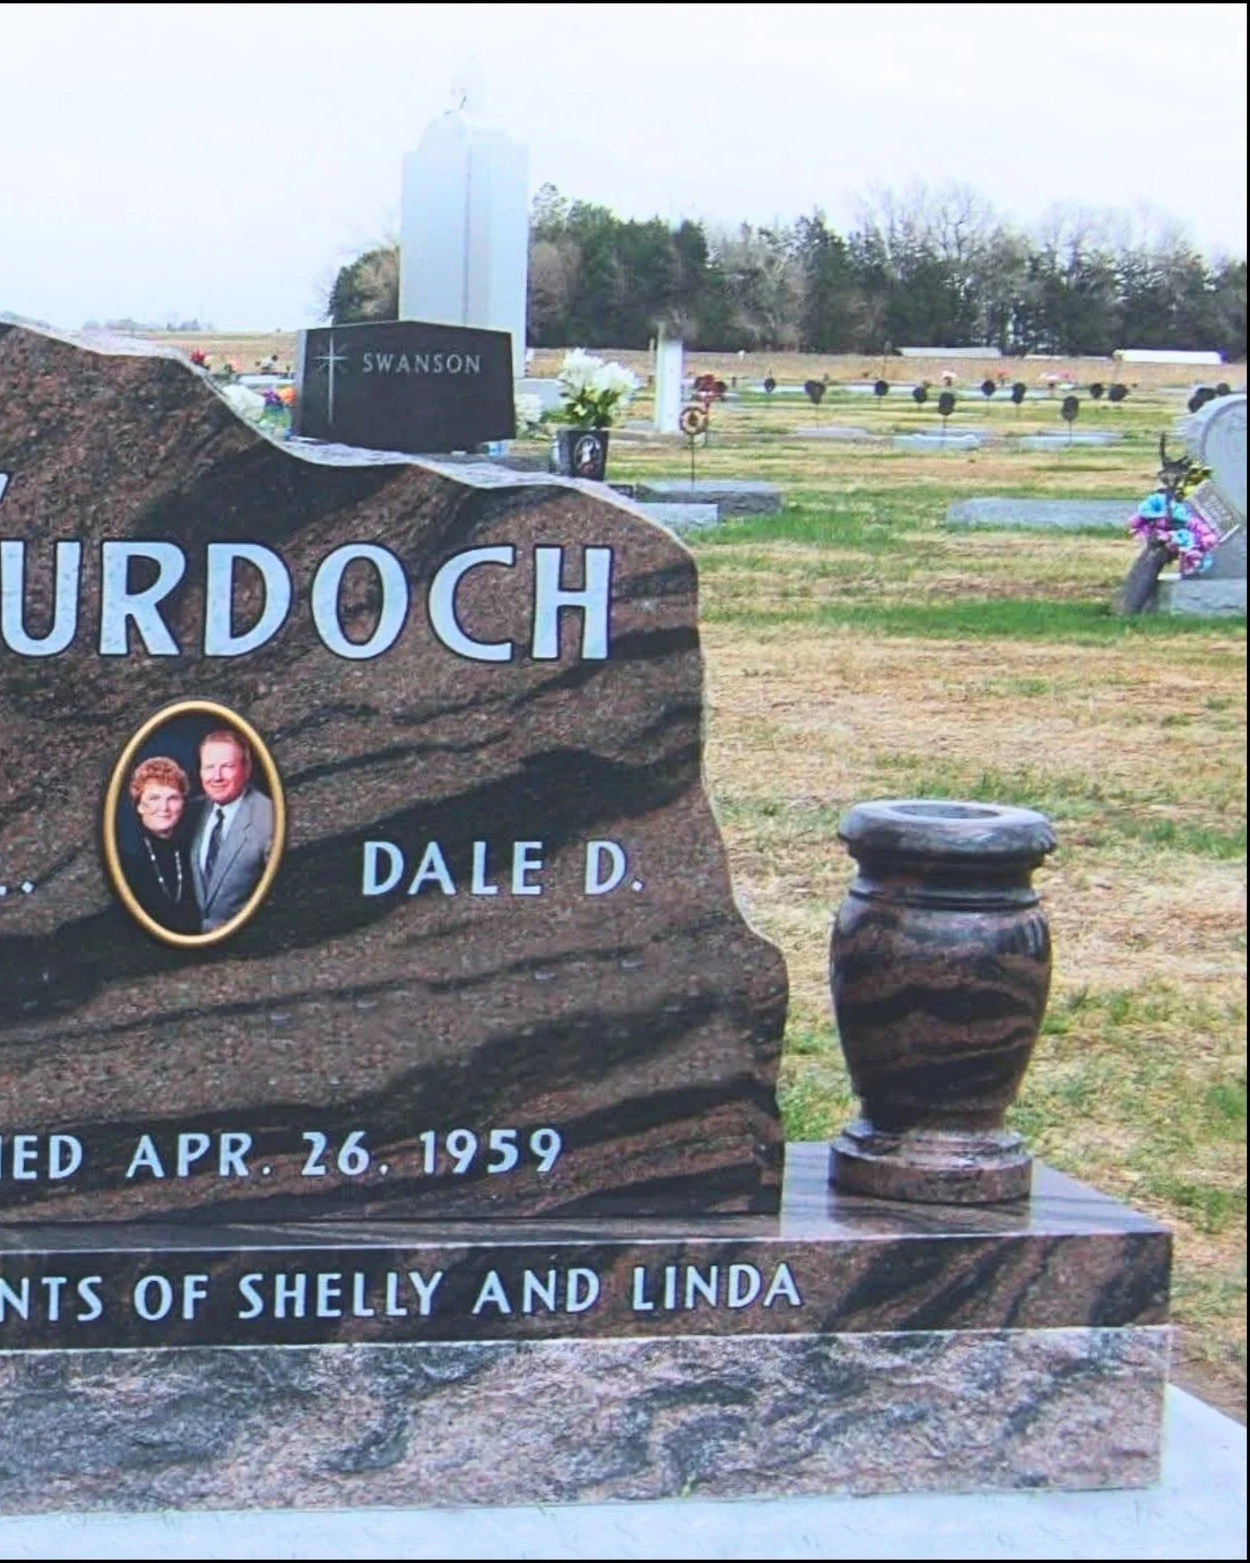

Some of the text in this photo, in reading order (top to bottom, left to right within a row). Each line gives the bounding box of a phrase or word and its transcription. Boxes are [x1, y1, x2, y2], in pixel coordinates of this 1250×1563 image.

[361, 352, 482, 376] SWANSON
[363, 841, 643, 895] DALE D.
[125, 1133, 273, 1179] APR.
[420, 1128, 560, 1174] 1959
[134, 1275, 208, 1320] OF
[239, 1271, 443, 1319] SHELLY
[472, 1268, 599, 1314] AND
[633, 1263, 800, 1310] LINDA
